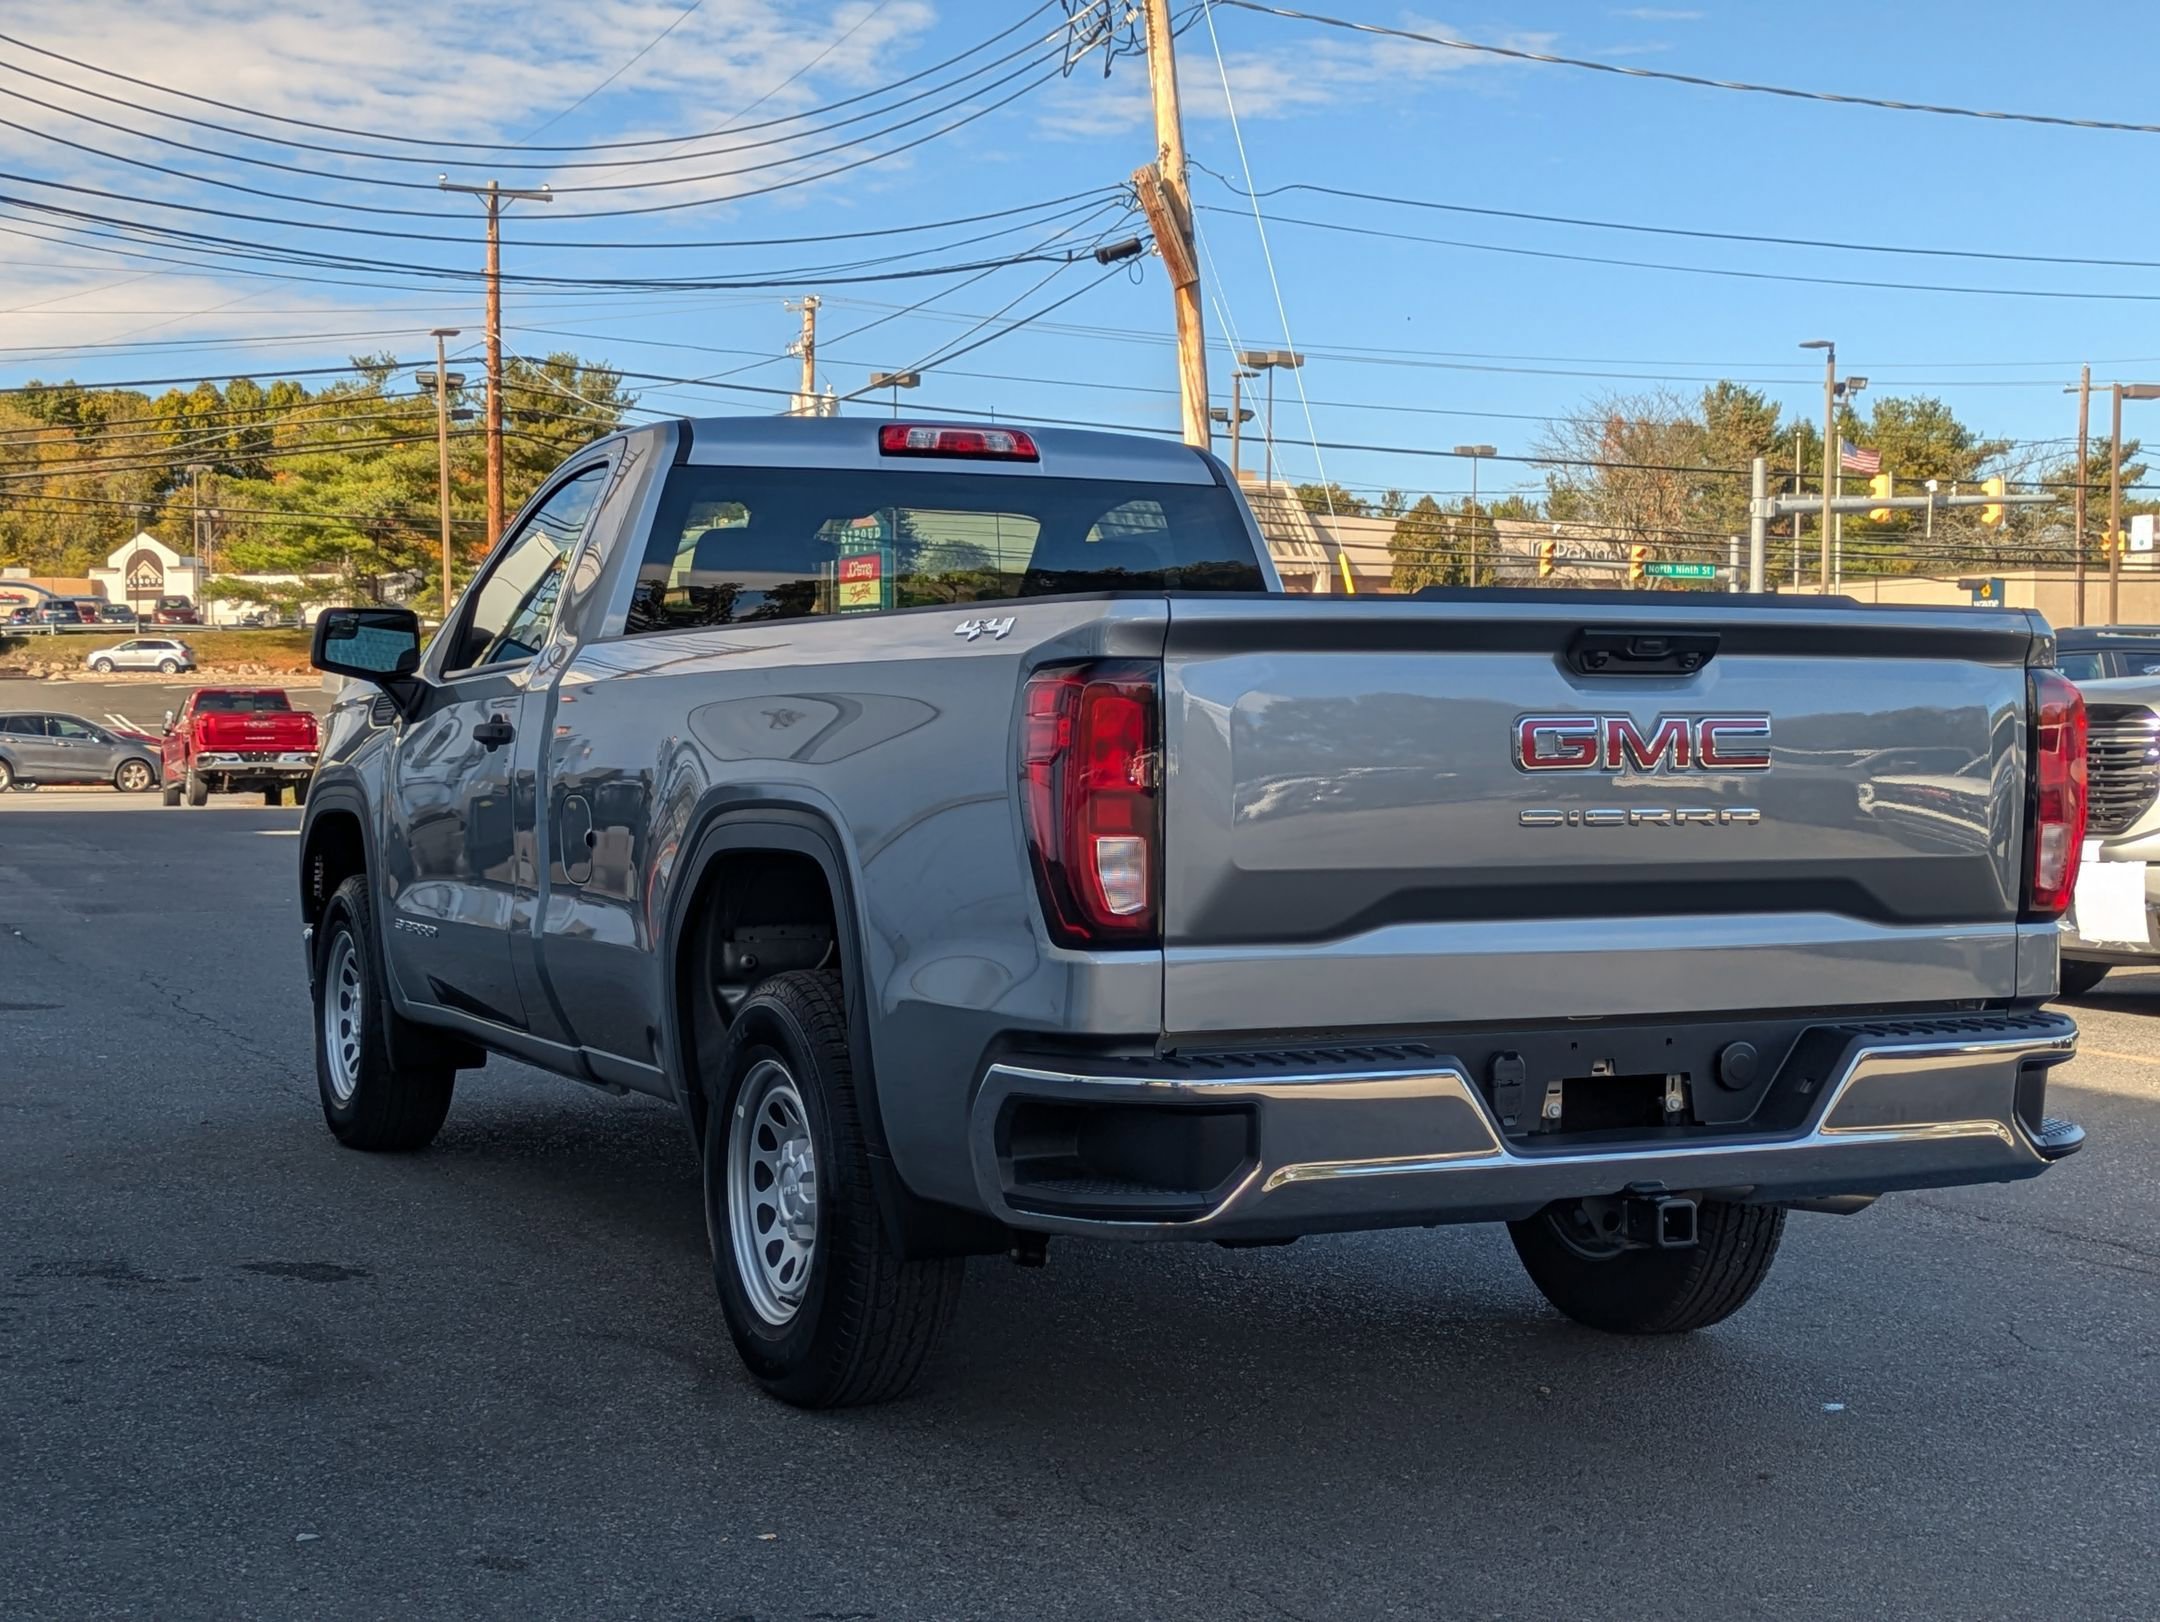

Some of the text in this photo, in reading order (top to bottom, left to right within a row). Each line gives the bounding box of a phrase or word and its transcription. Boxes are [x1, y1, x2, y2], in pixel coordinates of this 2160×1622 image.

[1648, 564, 1712, 576] North Ninth St
[1514, 713, 1772, 774] GMC
[1518, 807, 1762, 827] SIERRA
